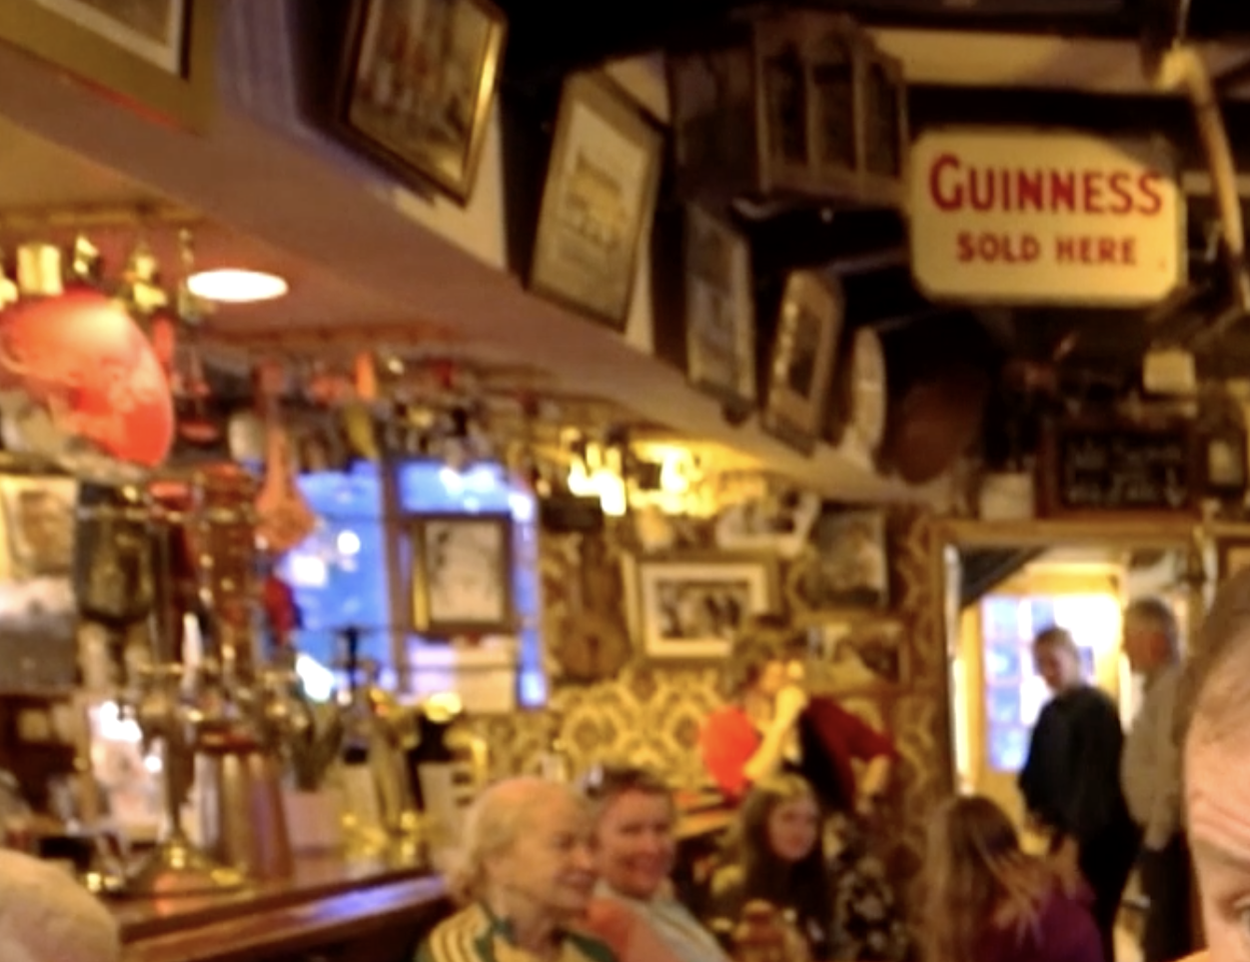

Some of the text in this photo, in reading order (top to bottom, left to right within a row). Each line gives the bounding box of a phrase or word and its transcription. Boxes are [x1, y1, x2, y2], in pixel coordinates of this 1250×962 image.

[930, 154, 1162, 215] GUINNESS
[957, 232, 1136, 266] SOLD HERE
